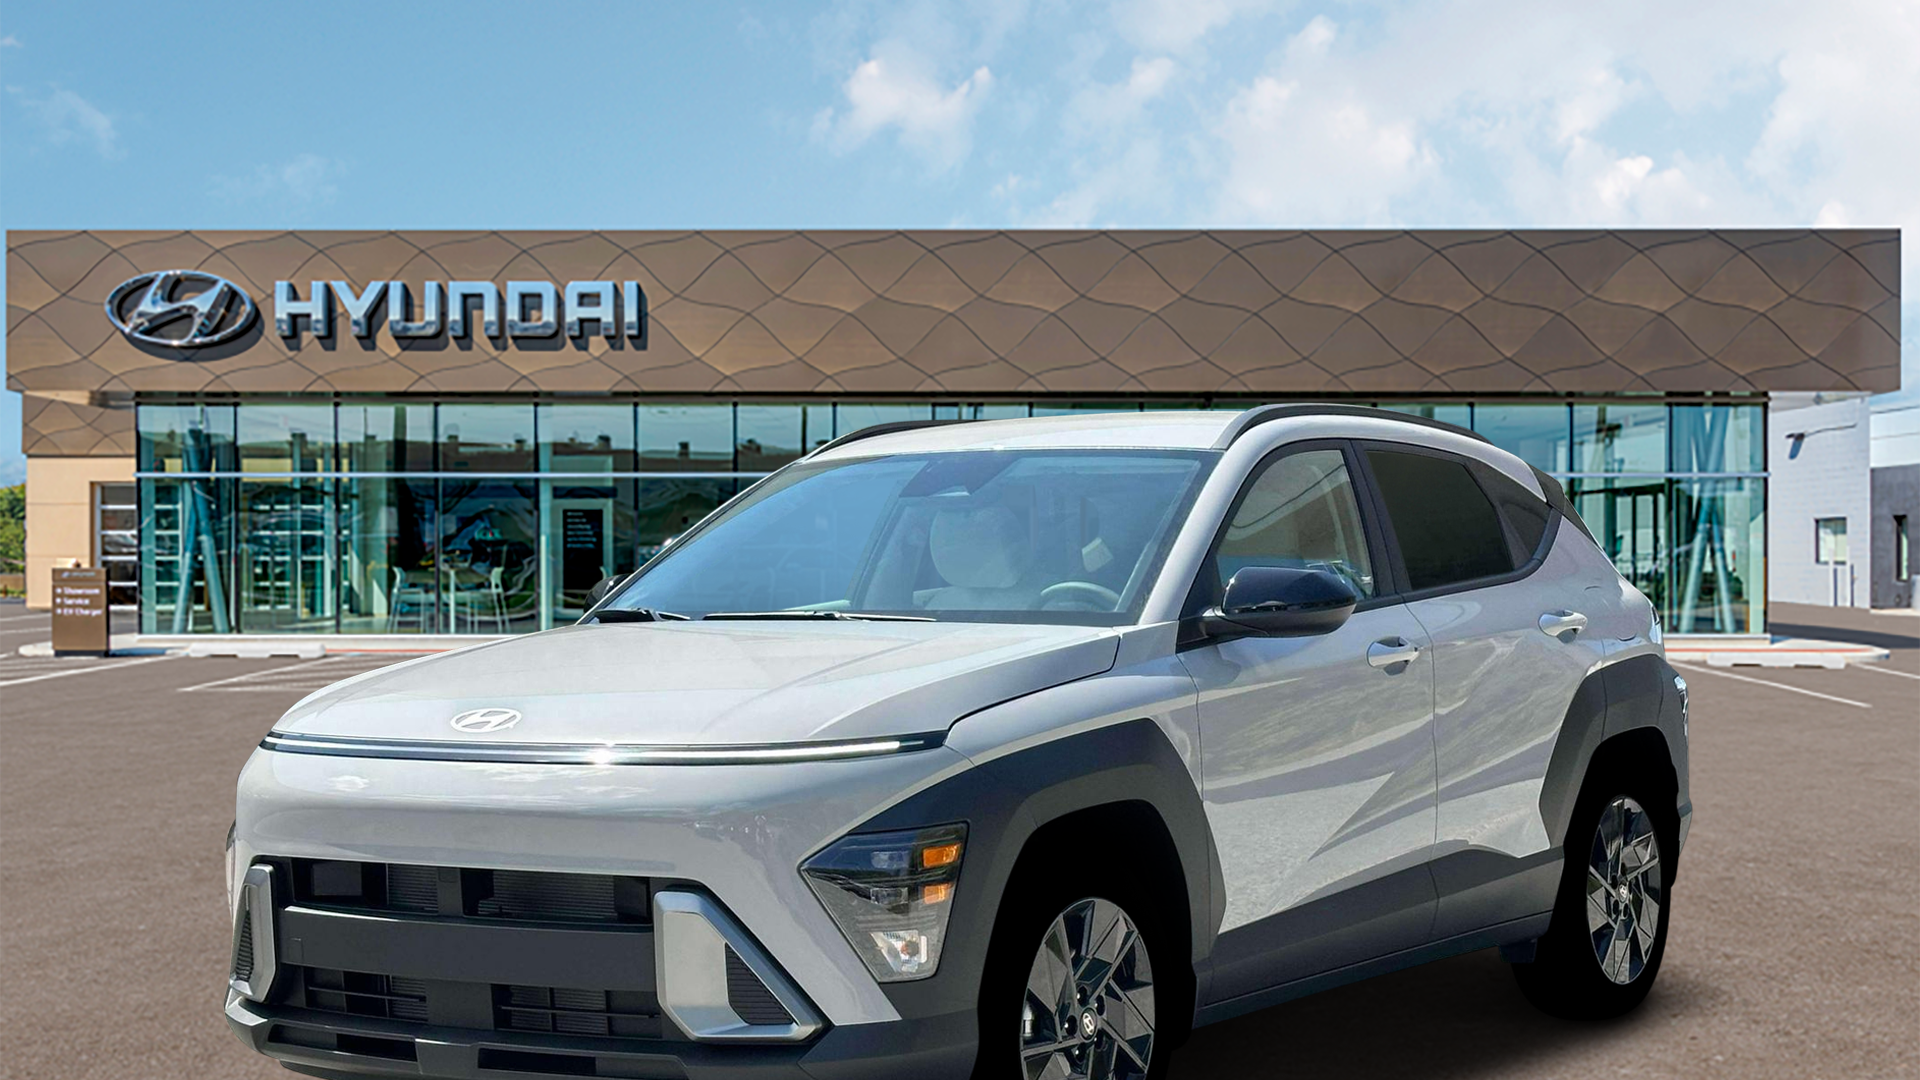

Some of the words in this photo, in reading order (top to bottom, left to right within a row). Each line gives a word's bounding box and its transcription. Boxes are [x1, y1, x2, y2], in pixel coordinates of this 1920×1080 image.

[275, 280, 641, 341] HYUNDAI
[63, 587, 100, 595] Showroom
[63, 597, 90, 605] Service
